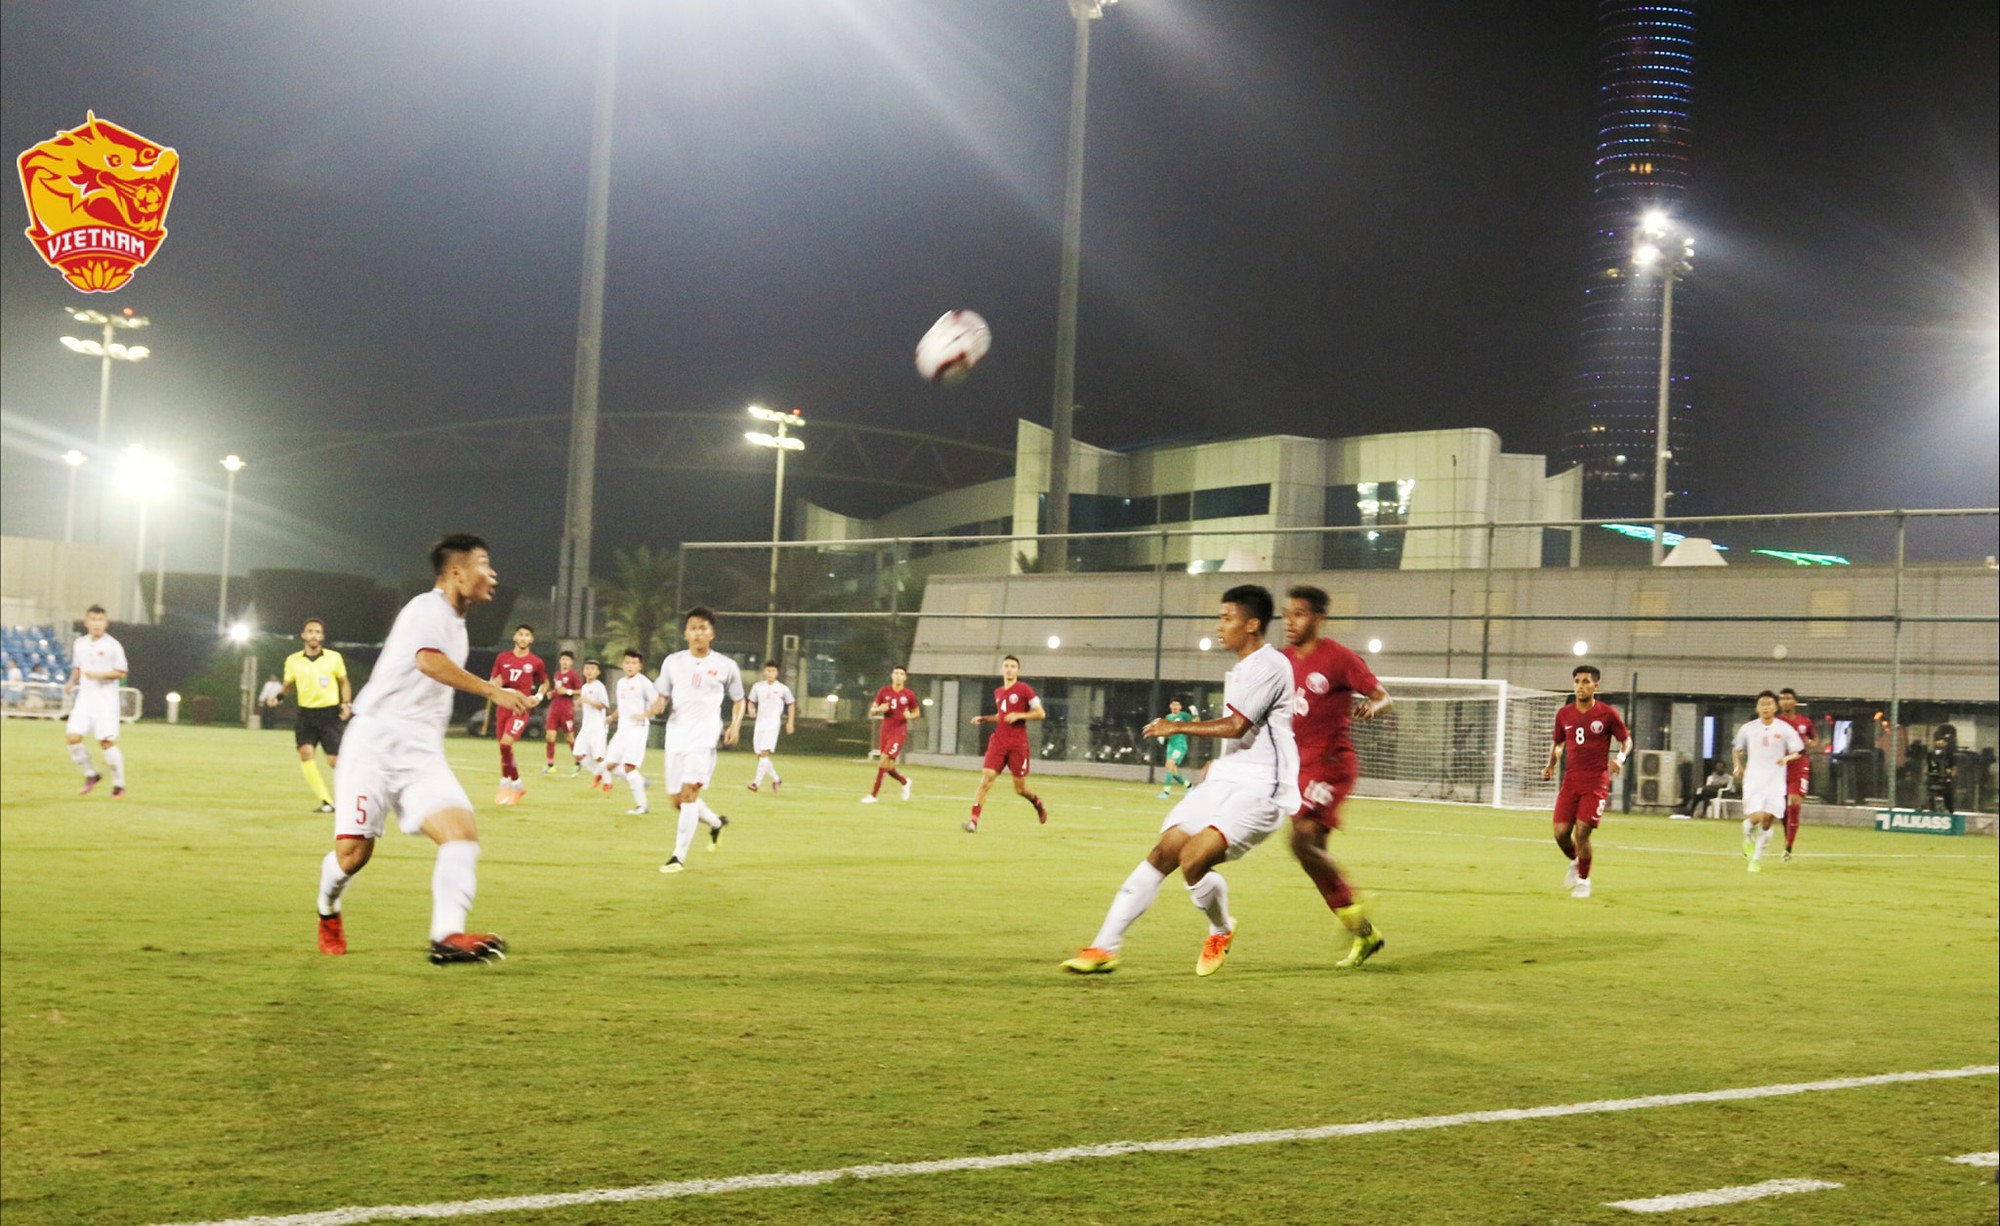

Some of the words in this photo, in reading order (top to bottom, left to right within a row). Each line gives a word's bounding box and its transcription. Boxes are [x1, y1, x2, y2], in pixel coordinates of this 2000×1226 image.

[509, 668, 522, 682] 17
[890, 698, 897, 710] 5
[1000, 699, 1007, 713] 4
[512, 719, 525, 732] 17
[1575, 727, 1585, 745] 8
[889, 742, 899, 755] 5
[355, 795, 368, 825] 5
[1596, 799, 1606, 816] 8
[1892, 814, 1952, 830] ALKASS
